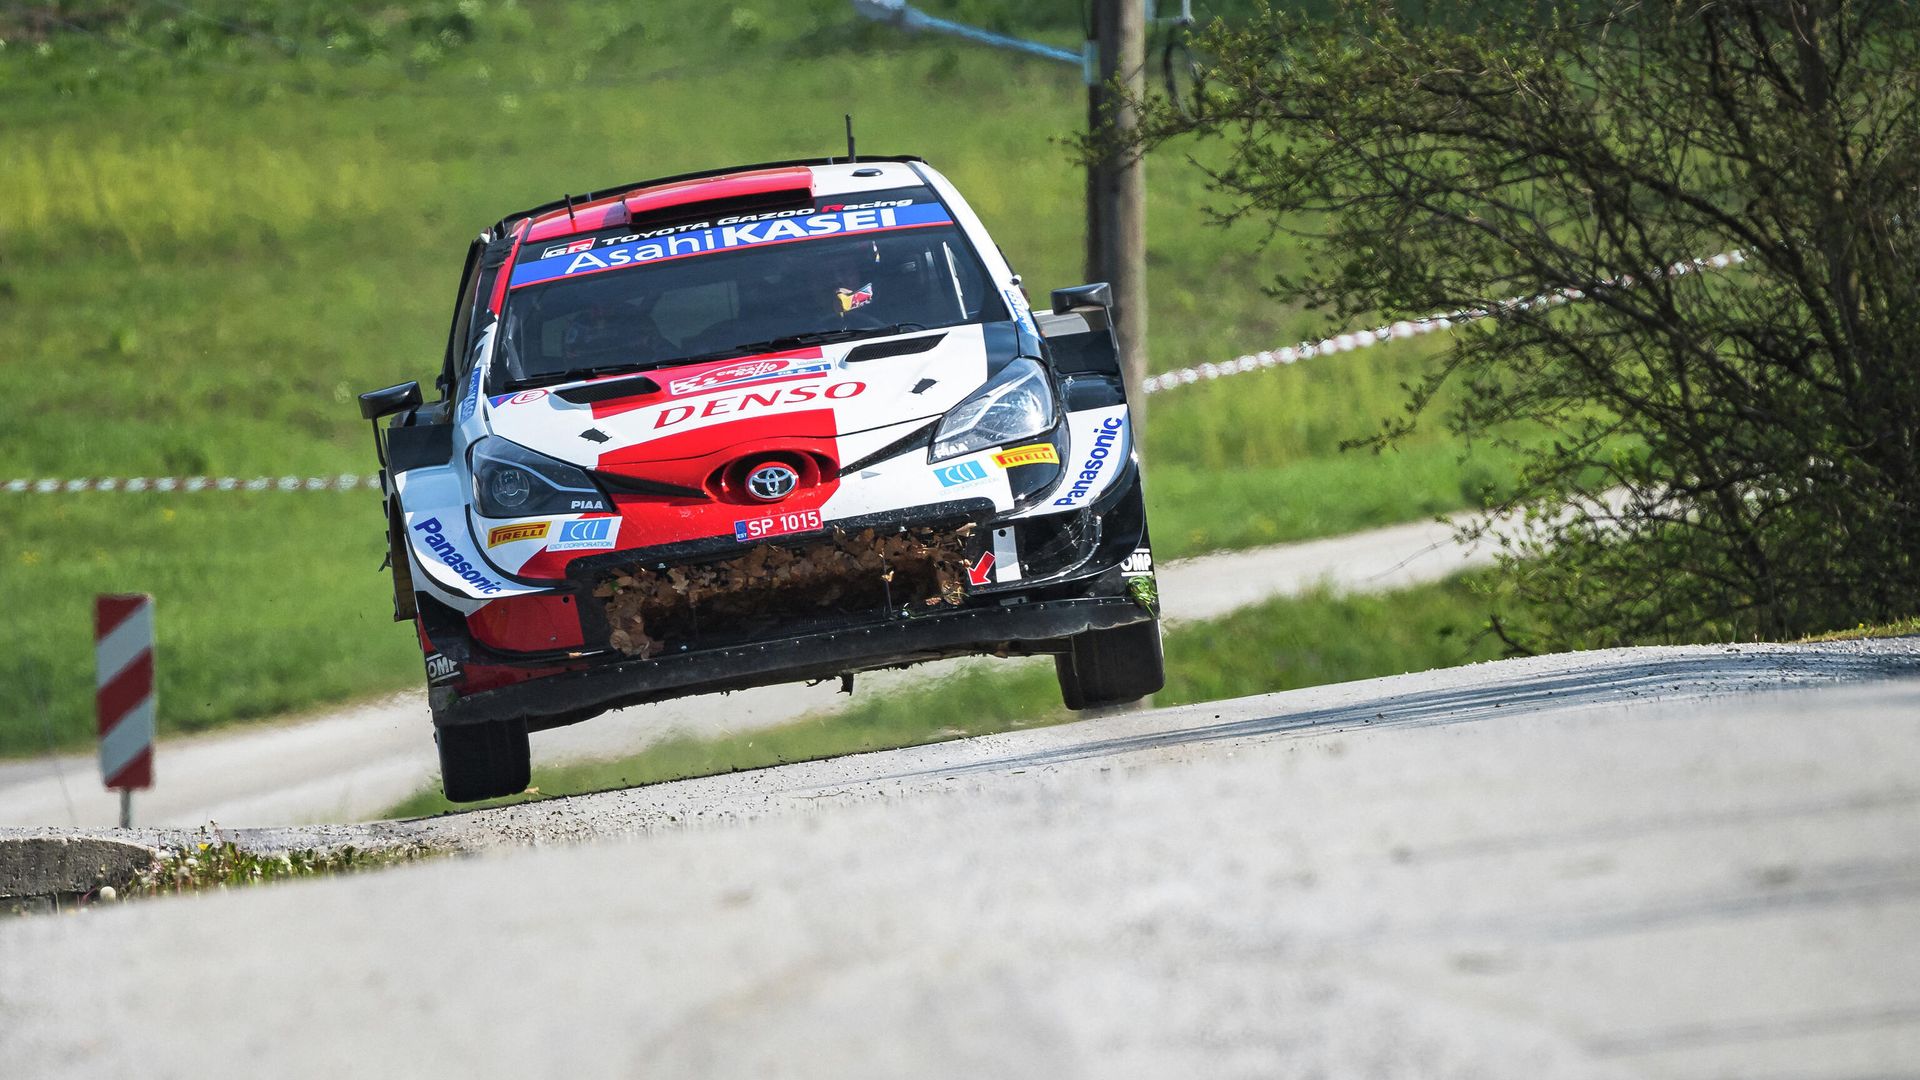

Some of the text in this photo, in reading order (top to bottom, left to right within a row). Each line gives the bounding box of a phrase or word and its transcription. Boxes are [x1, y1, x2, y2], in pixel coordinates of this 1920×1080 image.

[602, 221, 710, 245] TOYOTA
[717, 208, 815, 225] GAZOO
[821, 199, 913, 213] Racing
[654, 381, 867, 429] DENSO
[996, 447, 1053, 465] PIRELLI
[1053, 417, 1123, 506] Panasonic
[570, 500, 604, 509] PIAA
[491, 523, 546, 545] PIRELLI
[748, 511, 819, 536] SP 1015
[414, 517, 502, 595] Panasonic
[563, 541, 613, 549] CORPORATION
